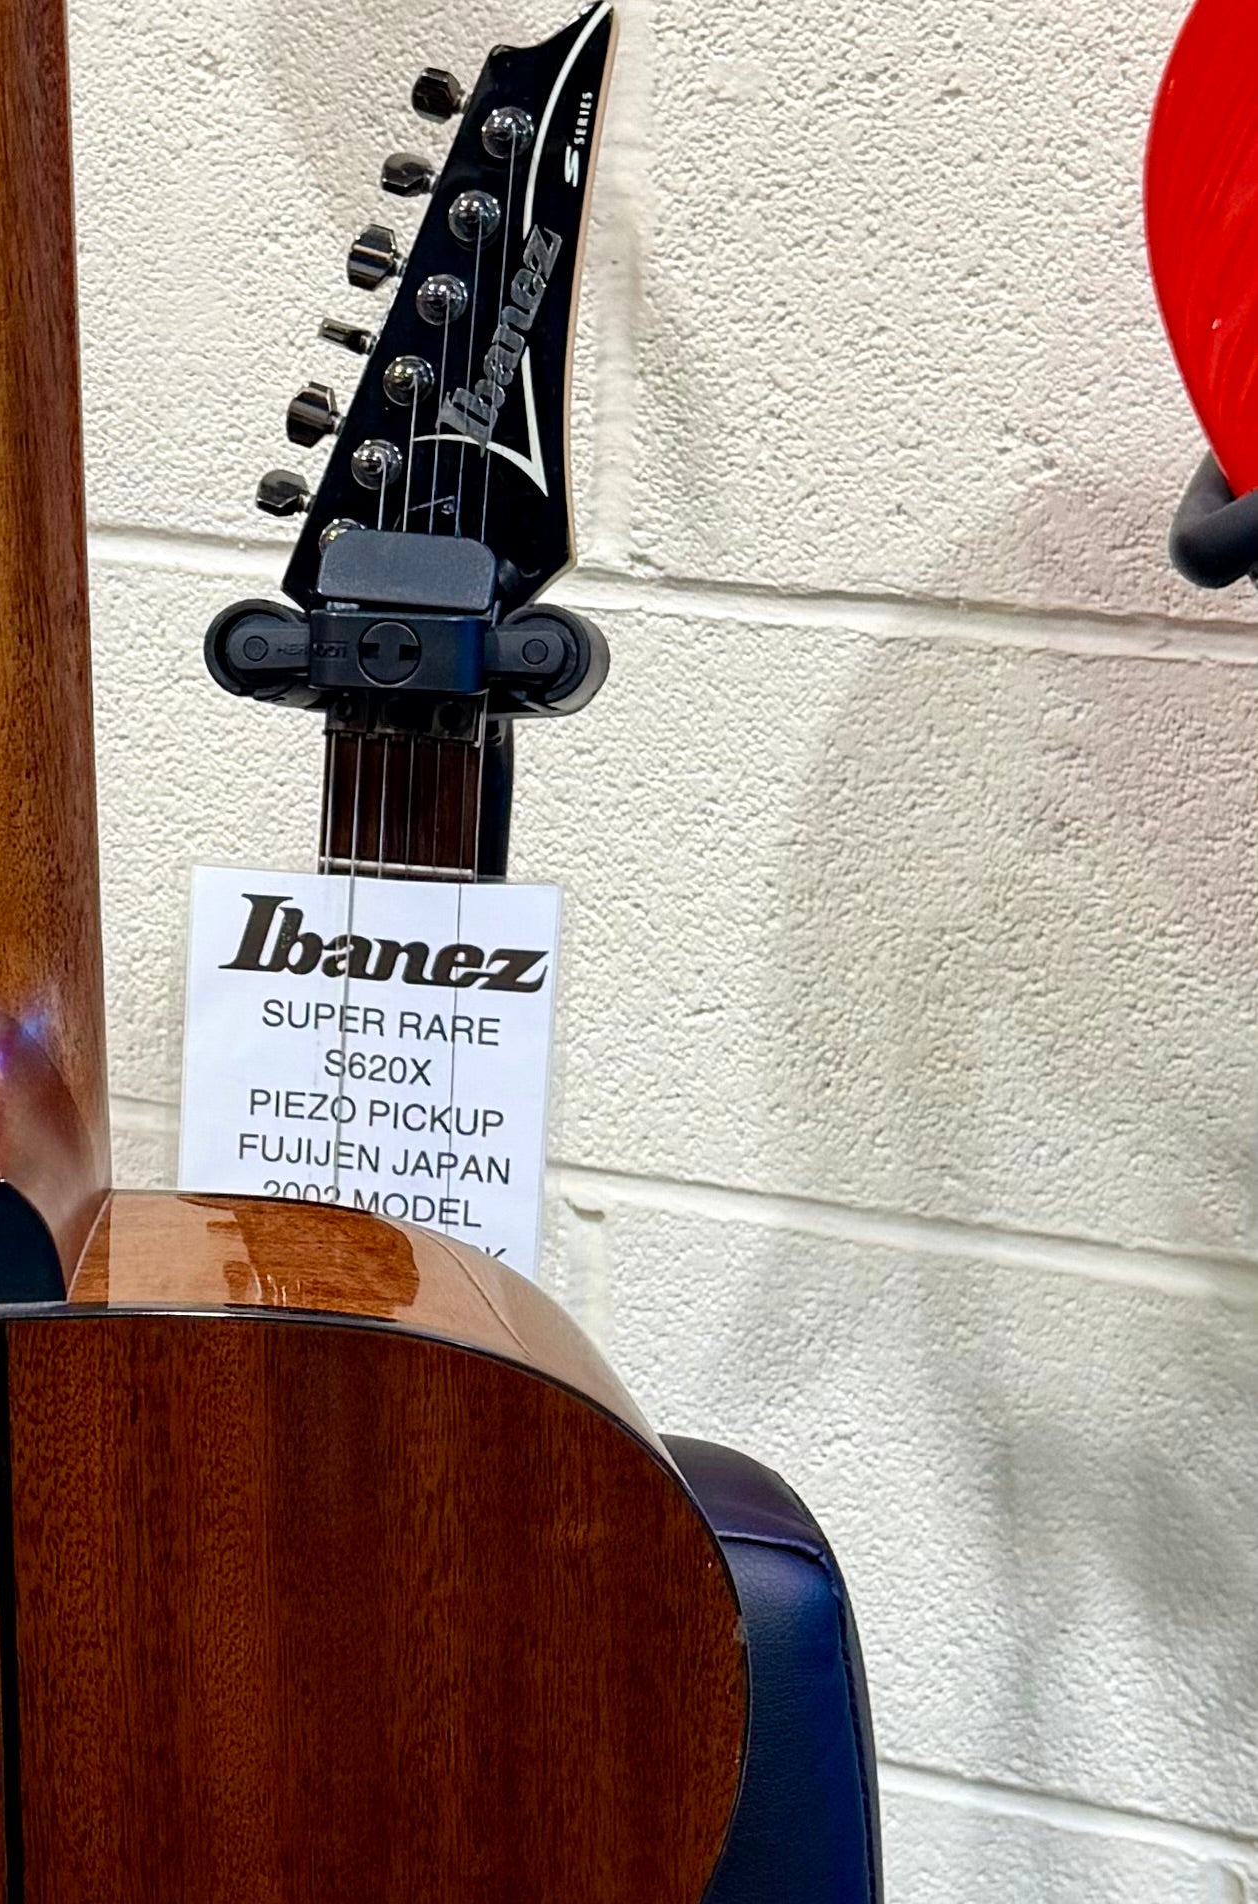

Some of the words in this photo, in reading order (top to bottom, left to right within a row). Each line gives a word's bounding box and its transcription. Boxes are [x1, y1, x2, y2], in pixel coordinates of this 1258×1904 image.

[564, 145, 579, 187] S
[573, 91, 593, 145] SERIES
[435, 224, 563, 458] Ibanez
[219, 893, 549, 994] Ibanez
[261, 998, 385, 1038] SUPER
[399, 1011, 501, 1047] RARE
[324, 1048, 432, 1087] S620X
[250, 1089, 356, 1125] PIEZO
[369, 1099, 504, 1138] PICKUP
[239, 1133, 380, 1173] FUJIJEN
[392, 1148, 510, 1186] JAPAN
[353, 1188, 482, 1228] MODEL
